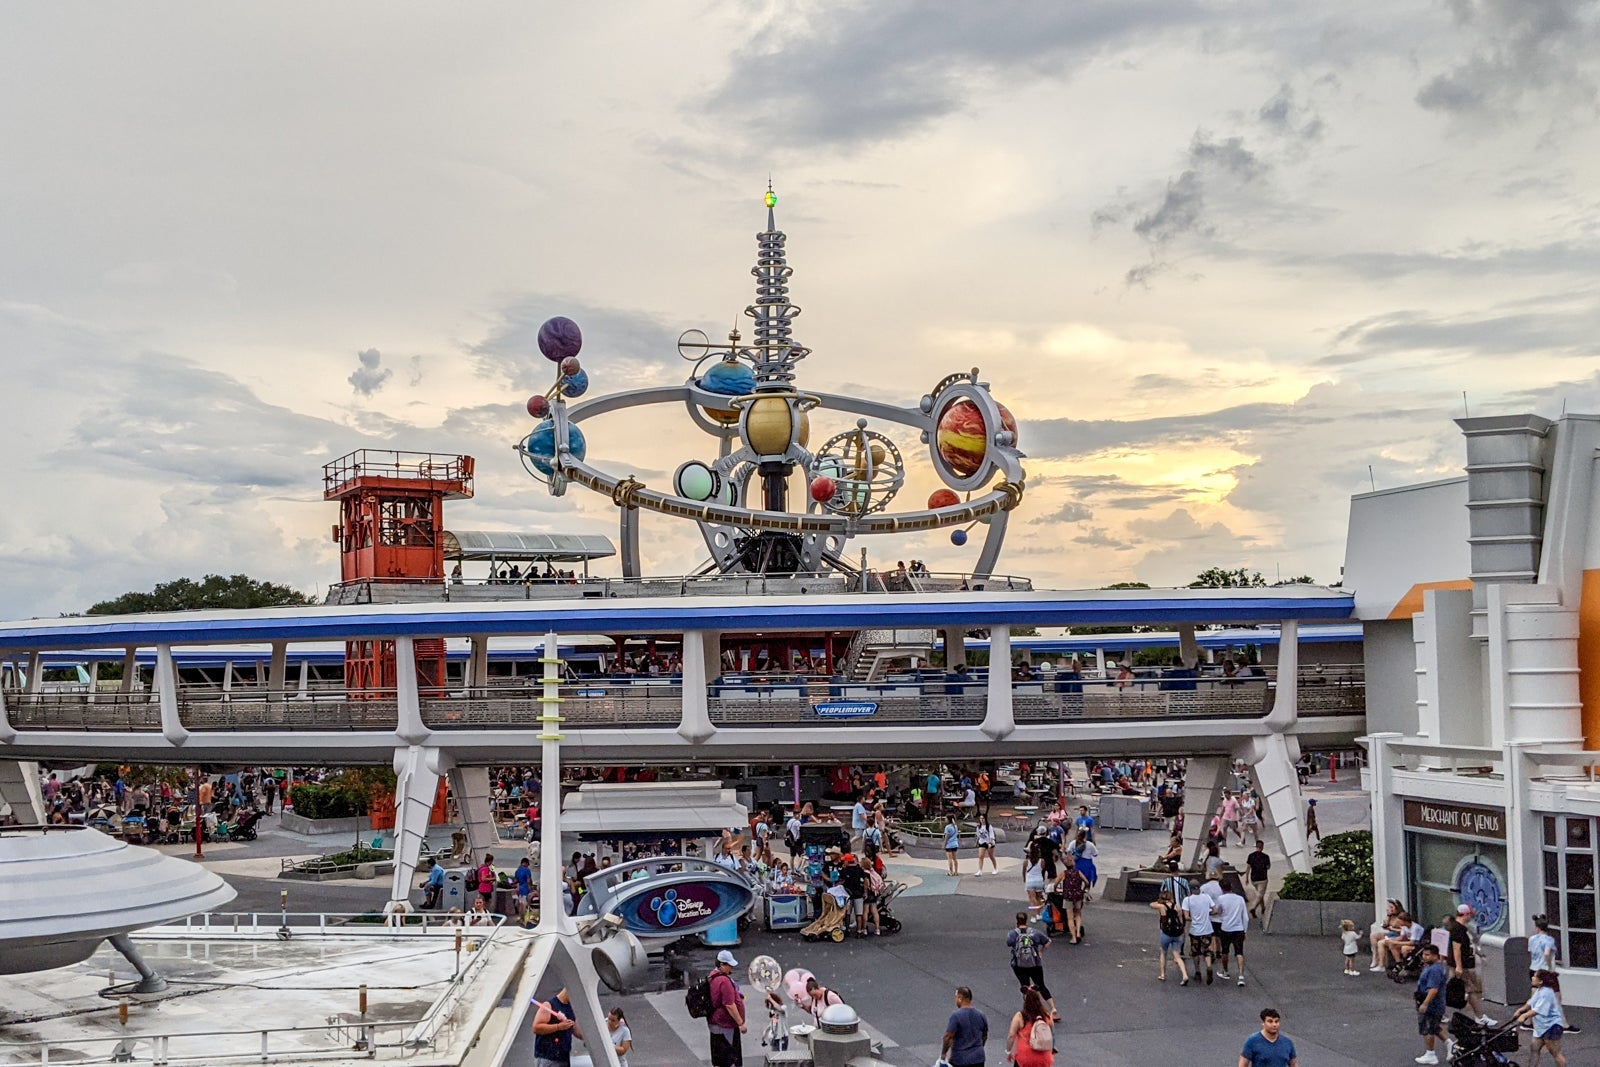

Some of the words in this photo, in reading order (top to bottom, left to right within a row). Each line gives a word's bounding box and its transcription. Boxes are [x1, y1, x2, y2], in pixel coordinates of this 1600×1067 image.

[1421, 805, 1459, 826] MERCHANT
[1461, 812, 1472, 827] OF
[1473, 813, 1499, 833] VENUS
[676, 899, 704, 911] Disney
[678, 910, 699, 918] Vacation
[700, 908, 712, 916] Club
